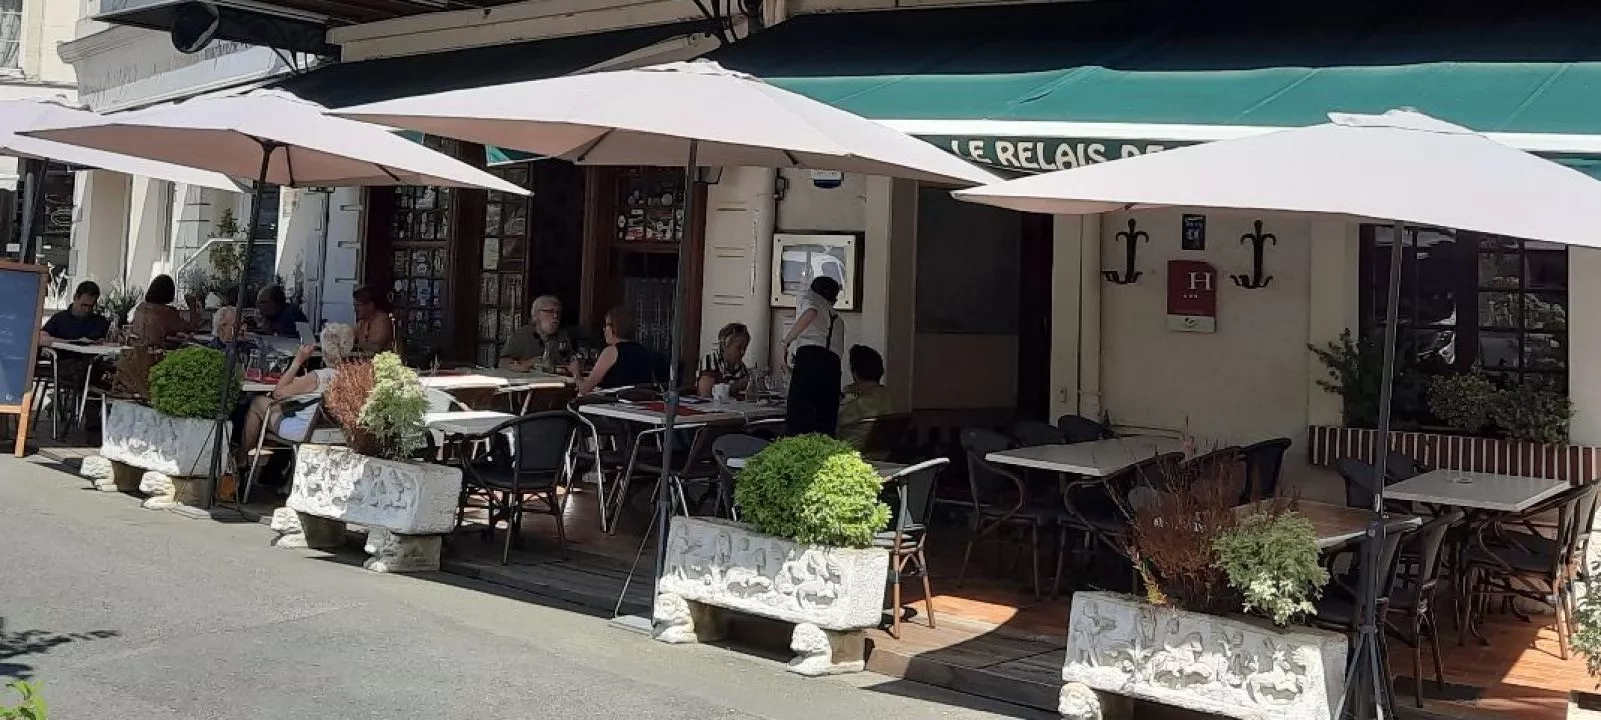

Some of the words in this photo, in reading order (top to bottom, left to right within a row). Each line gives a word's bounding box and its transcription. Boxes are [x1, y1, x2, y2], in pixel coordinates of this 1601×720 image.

[951, 140, 992, 163] LE
[995, 141, 1106, 169] RELAIS
[1188, 272, 1213, 290] H
